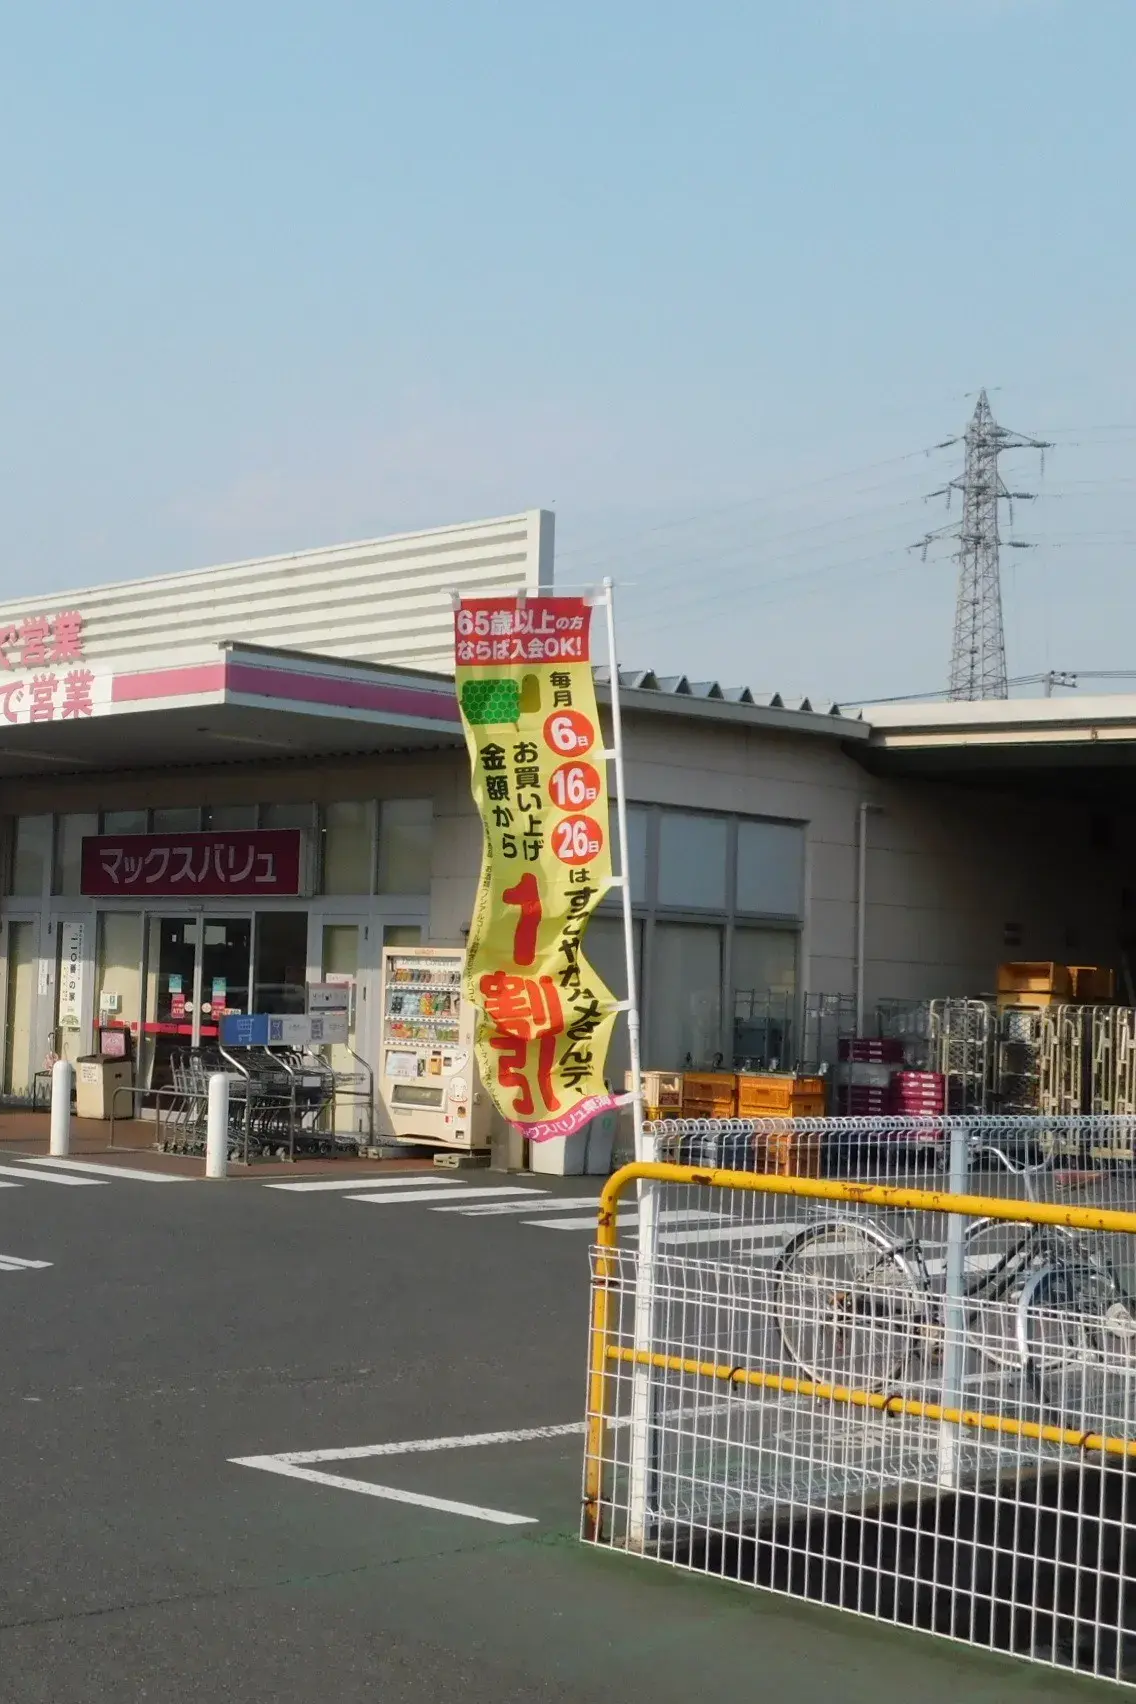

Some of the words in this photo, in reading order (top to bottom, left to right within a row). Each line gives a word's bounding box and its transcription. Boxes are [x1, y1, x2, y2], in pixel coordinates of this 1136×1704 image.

[456, 608, 585, 637] 65歳以上の方
[456, 636, 583, 661] ならば入会OK!
[549, 670, 573, 708] 毎月
[550, 716, 589, 752] 6日
[479, 741, 519, 860] 金額から
[513, 740, 545, 862] お買い上げ
[552, 767, 598, 806] 16日
[557, 820, 600, 860] 26日
[98, 843, 278, 885] マックスバリュ
[480, 872, 564, 1111] 1割引
